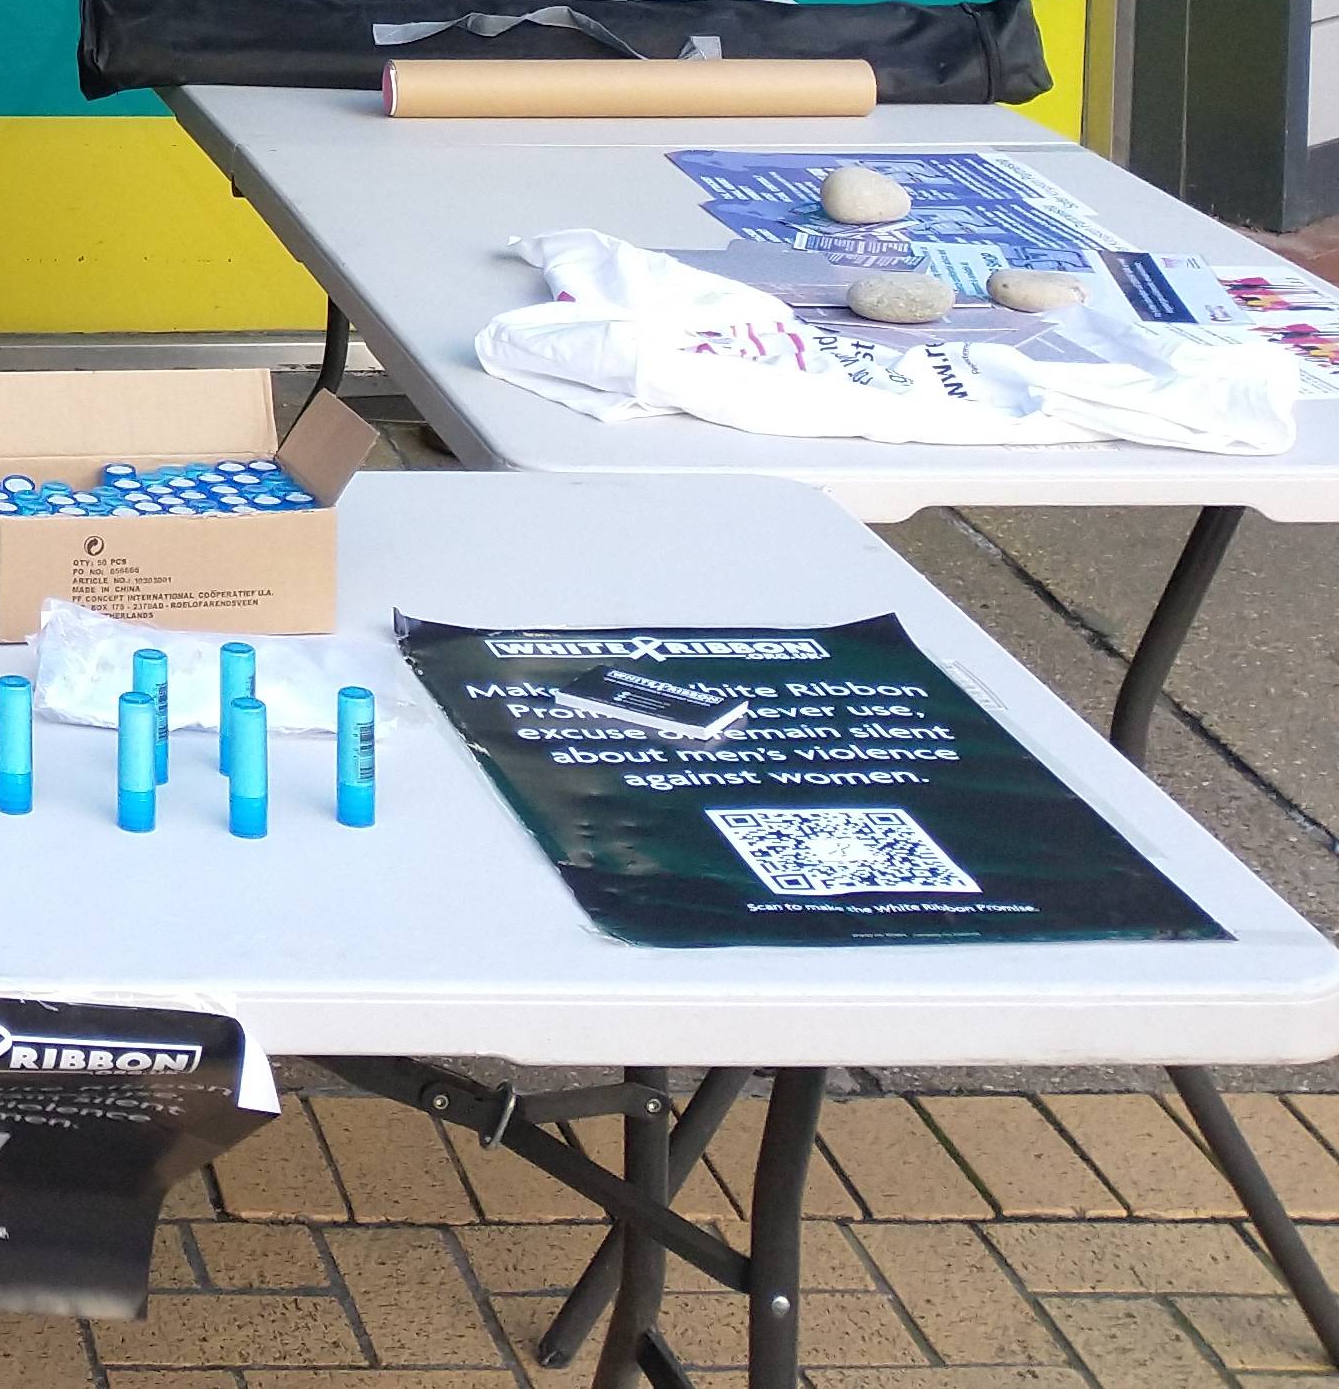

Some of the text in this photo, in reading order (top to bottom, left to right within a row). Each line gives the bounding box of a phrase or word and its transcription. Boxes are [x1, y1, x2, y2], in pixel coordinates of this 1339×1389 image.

[71, 586, 96, 594] MADE
[114, 585, 141, 593] CHINA
[72, 577, 109, 585] ARTICLE
[85, 594, 124, 603] CONCEPT
[127, 592, 195, 601] INTERNATIONAL
[503, 641, 817, 656] WHITE RIBBON
[789, 681, 928, 698] Ribbon
[845, 703, 926, 720] use,
[517, 723, 647, 740] excuse
[849, 722, 955, 740] silent
[550, 744, 960, 764] about men's violence
[623, 768, 930, 791] against women.
[747, 903, 1040, 914] Scan to make the White Ribbon Promise.
[11, 1044, 190, 1071] RIBBON
